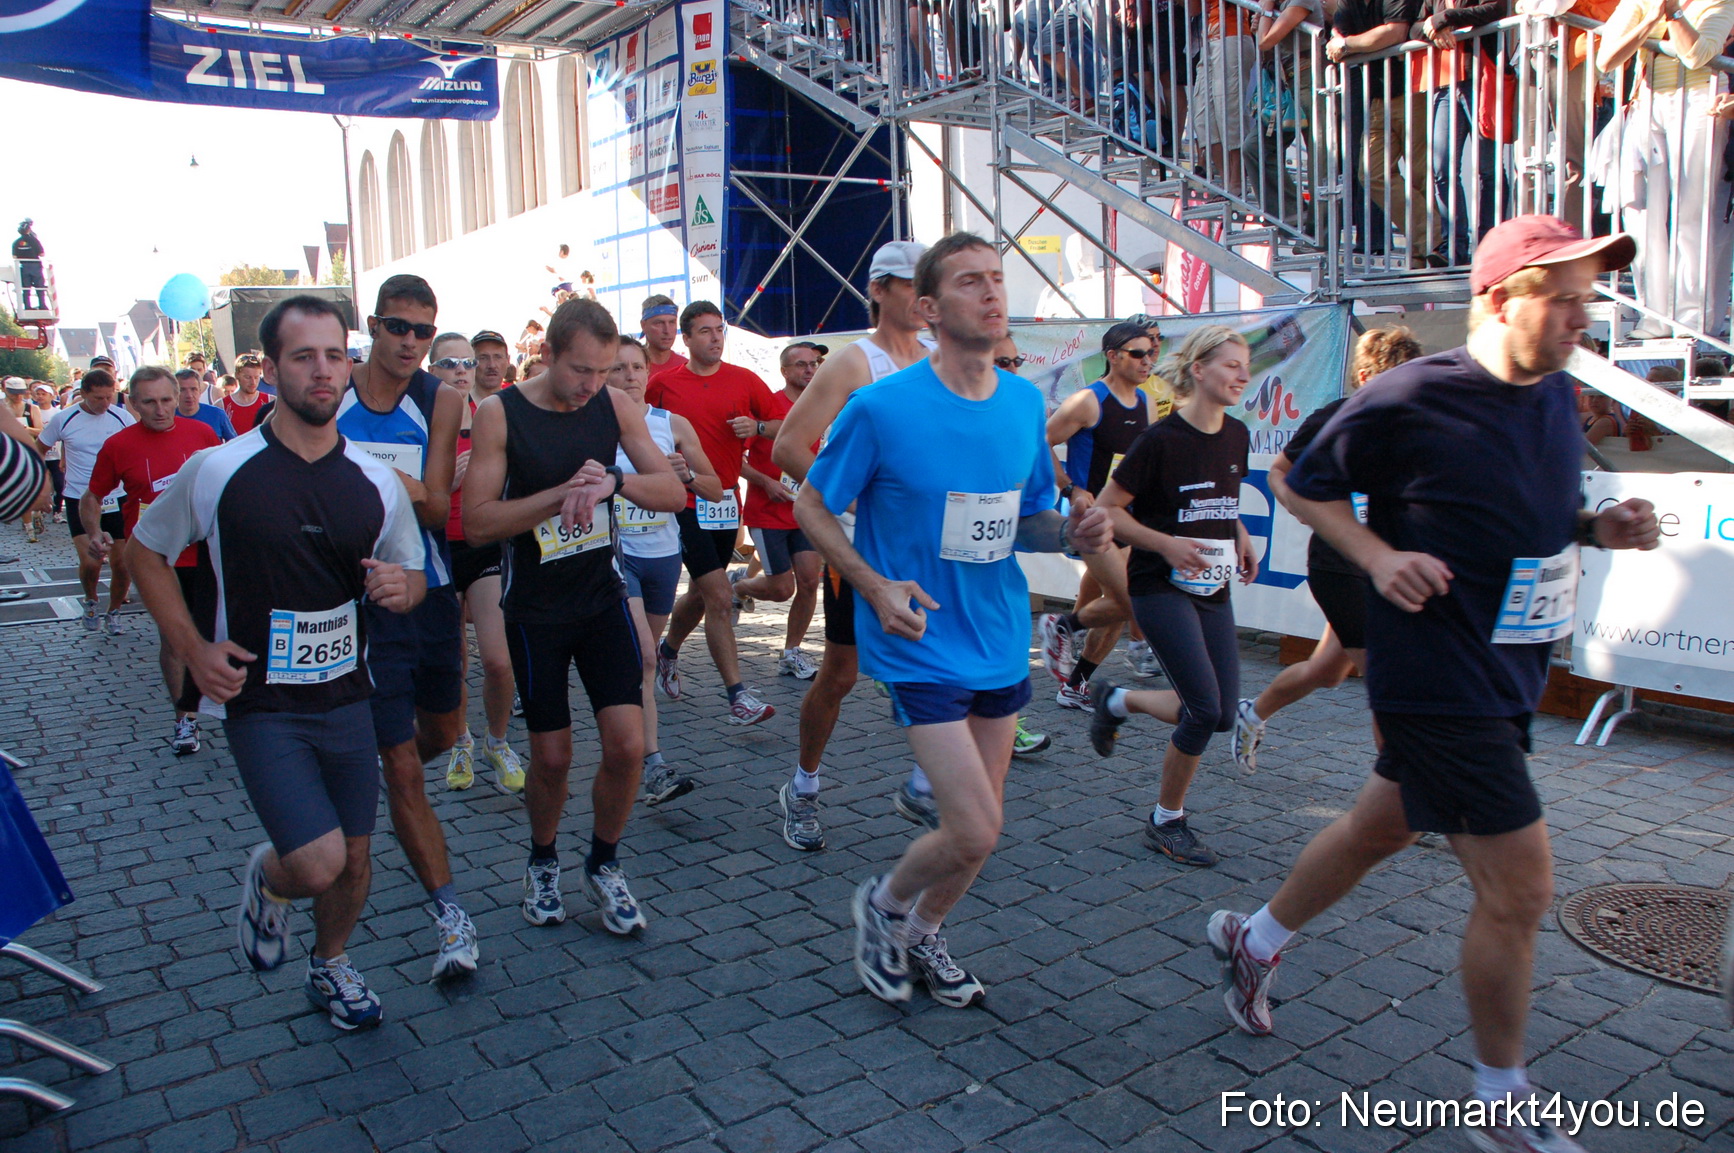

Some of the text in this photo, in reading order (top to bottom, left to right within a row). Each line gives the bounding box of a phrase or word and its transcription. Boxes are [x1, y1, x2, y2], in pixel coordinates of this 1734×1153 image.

[183, 44, 325, 95] ZIEL
[1051, 329, 1085, 365] Leben
[367, 450, 397, 462] mory
[614, 504, 621, 512] B
[709, 506, 736, 519] 3118
[541, 527, 550, 537] A
[971, 517, 1013, 541] 3501
[1197, 564, 1232, 581] 838
[296, 614, 349, 634] Matthias
[275, 634, 352, 665] B 2658
